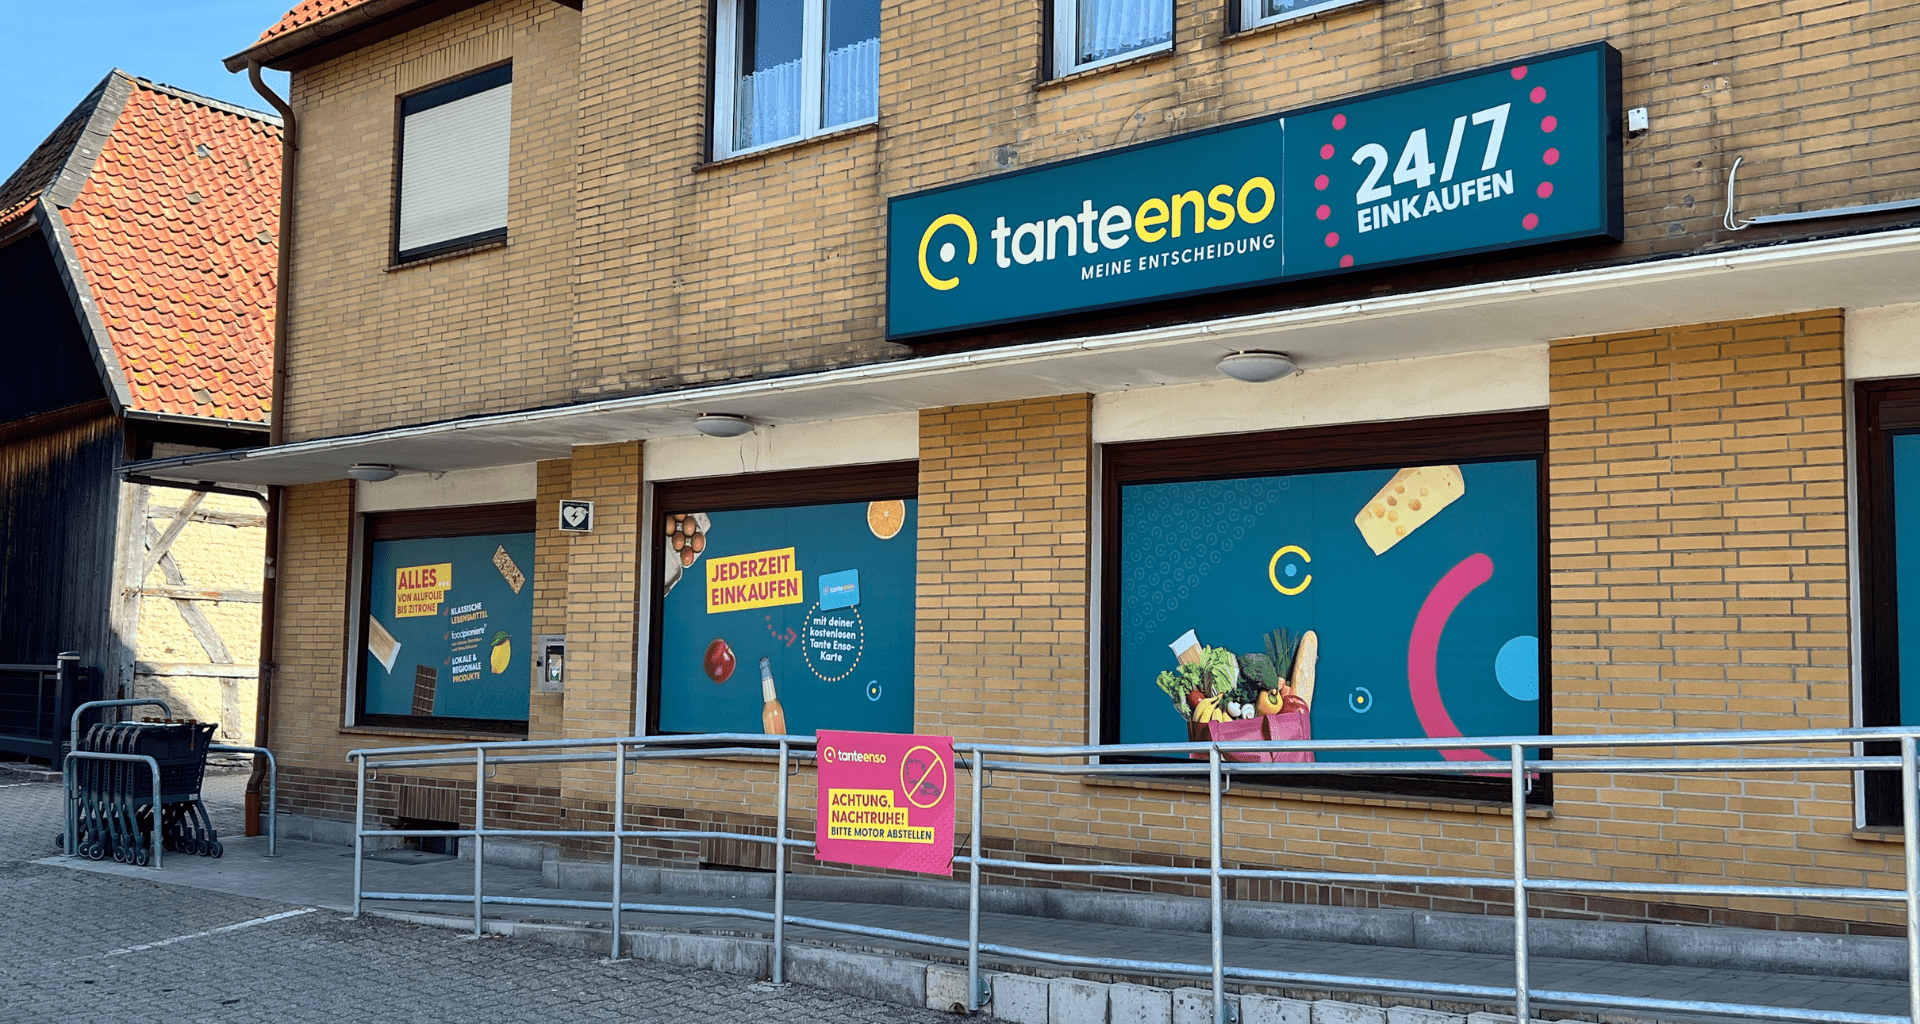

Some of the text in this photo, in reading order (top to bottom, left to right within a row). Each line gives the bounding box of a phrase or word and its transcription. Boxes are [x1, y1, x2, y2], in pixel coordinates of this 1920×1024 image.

[1351, 102, 1512, 206] 24/7
[1357, 169, 1515, 234] EINKAUFEN
[990, 176, 1276, 269] tanteenso
[1081, 233, 1277, 281] MEINE ENTSCHEIDUNG
[711, 554, 790, 583] JEDERZEIT
[397, 590, 442, 602] VON ALUFOLIE
[711, 577, 798, 606] EINKAUFEN
[398, 603, 436, 614] BIS ZITRONE
[451, 602, 482, 615] KLASSISCHE
[451, 611, 488, 624] LEBENSMITTEL
[813, 616, 854, 628] mit deiner
[810, 626, 856, 640] kostenlosen
[810, 638, 855, 651] Tante Enso-
[452, 655, 472, 665] LOKALE
[820, 651, 843, 662] Karte
[452, 662, 481, 674] REGIONALE
[453, 672, 480, 683] PRODUKTE
[838, 750, 887, 764] tanteenso
[832, 794, 891, 809] ACHTUNG,
[832, 810, 904, 825] NACHTRUHE!
[831, 826, 932, 841] BITTE MOTOR ABSTELLEN
